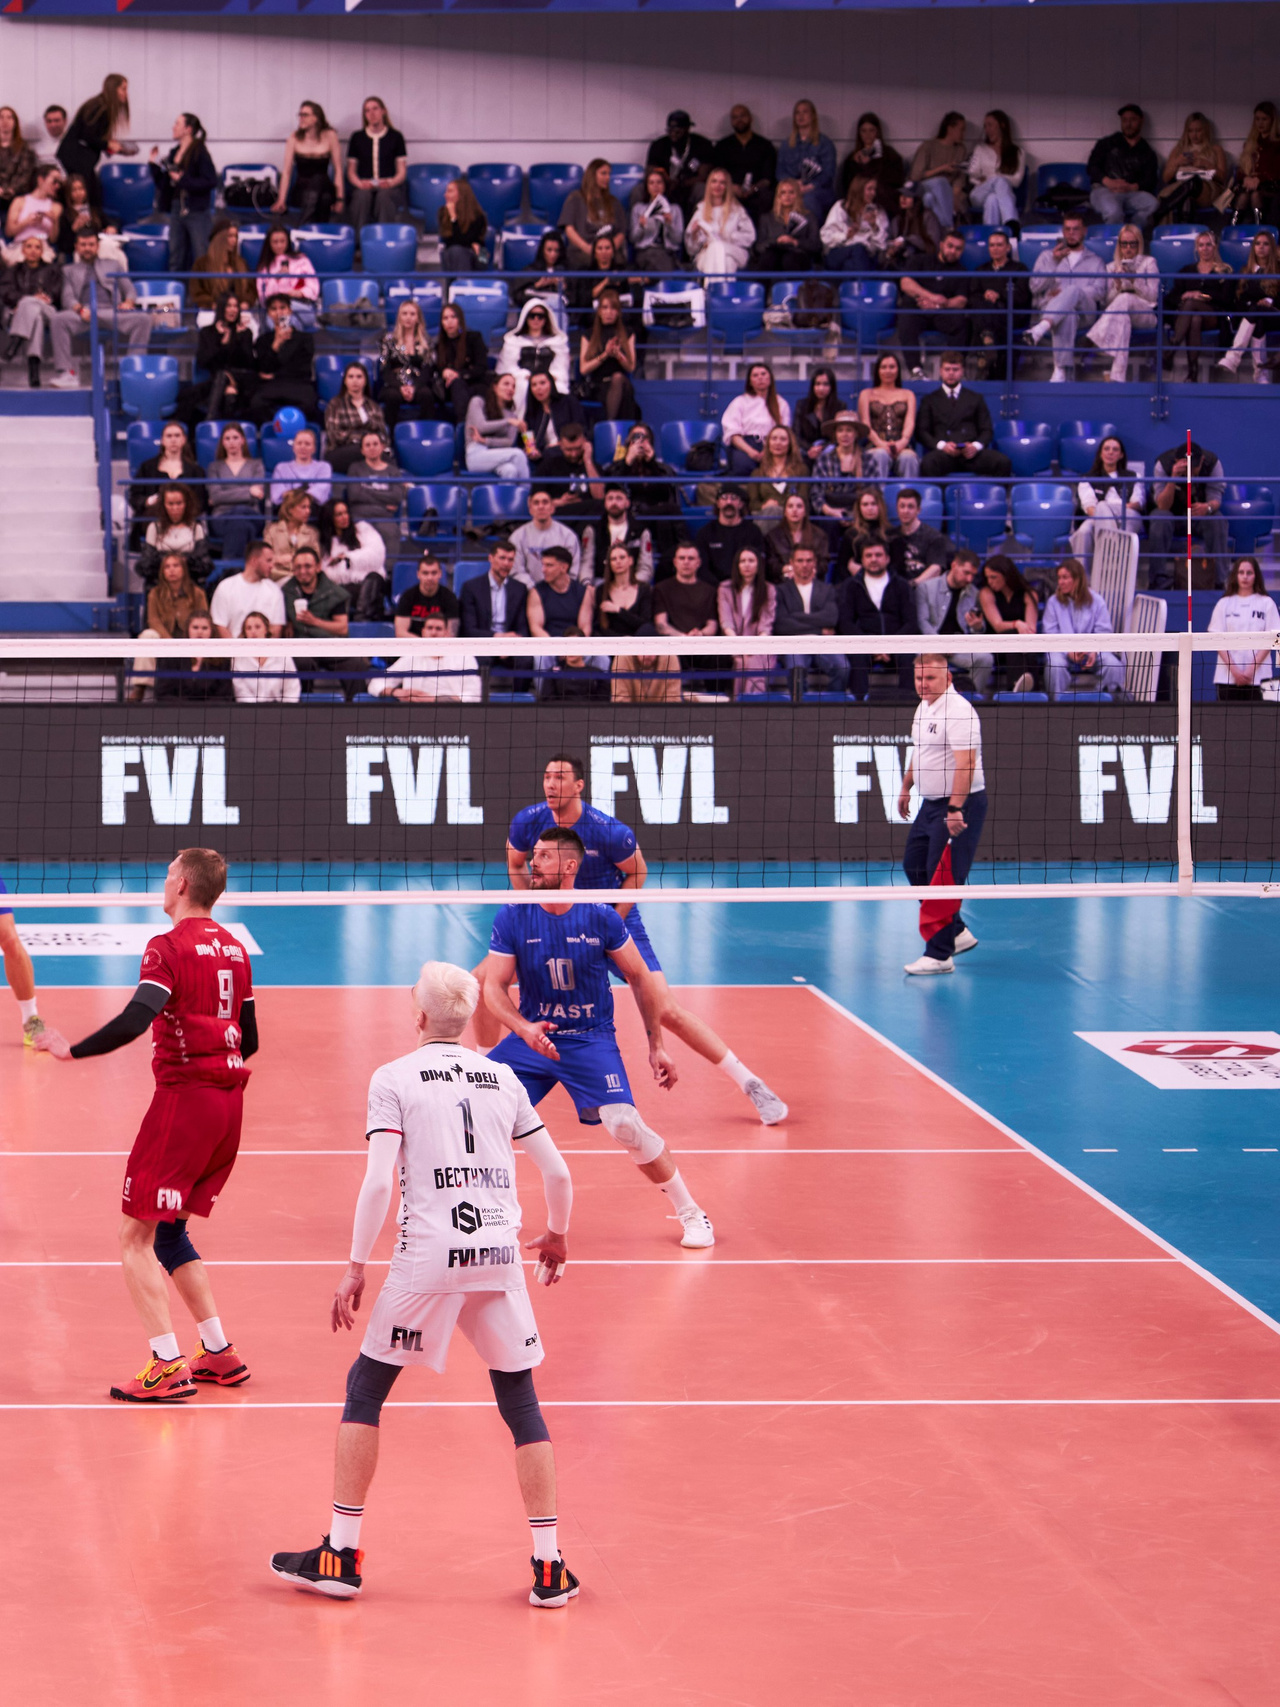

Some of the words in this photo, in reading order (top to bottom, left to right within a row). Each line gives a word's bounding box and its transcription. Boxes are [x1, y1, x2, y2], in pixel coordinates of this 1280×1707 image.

[101, 746, 240, 825] FVL
[346, 746, 484, 825] FVL
[590, 746, 729, 824] FVL
[833, 745, 925, 824] FV
[1079, 745, 1218, 824] FVL
[545, 957, 576, 992] 10
[217, 969, 235, 1019] 9
[538, 1002, 595, 1019] VAST
[420, 1070, 454, 1083] DIMA
[466, 1072, 499, 1085] БОЕЦ
[471, 1083, 500, 1091] company
[604, 1073, 621, 1089] 10
[455, 1097, 476, 1154] 1
[433, 1166, 511, 1190] БЕСТУЖЕВ
[448, 1246, 516, 1268] FVLPRO7
[390, 1326, 424, 1352] FVL
